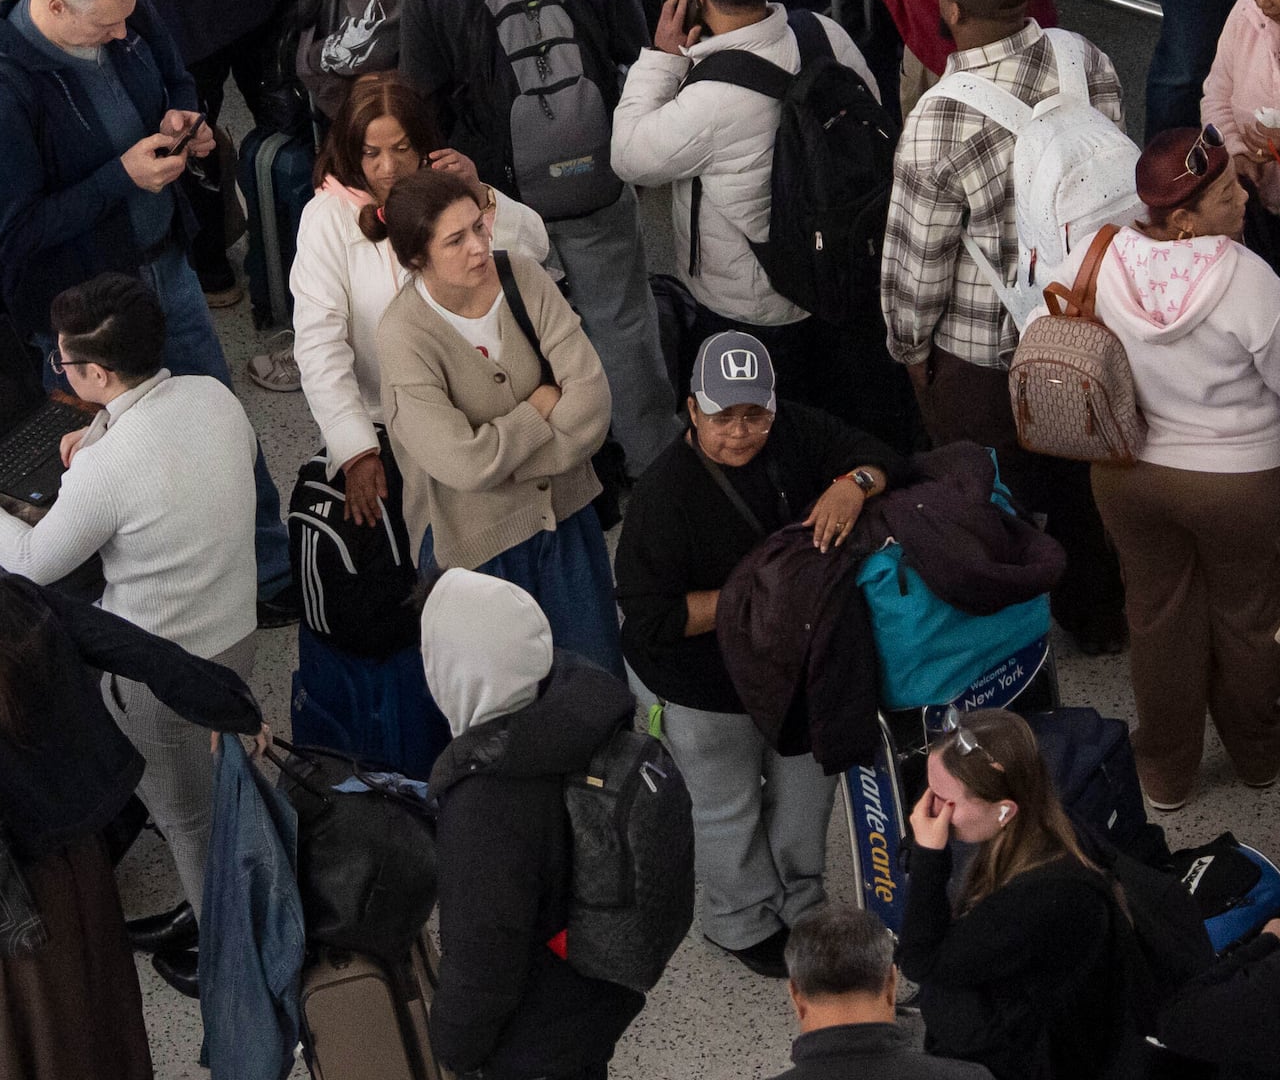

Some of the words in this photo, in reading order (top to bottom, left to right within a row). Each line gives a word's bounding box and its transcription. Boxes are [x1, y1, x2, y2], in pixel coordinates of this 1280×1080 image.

[964, 687, 995, 712] New
[998, 664, 1024, 690] York
[970, 664, 1007, 691] Welcome
